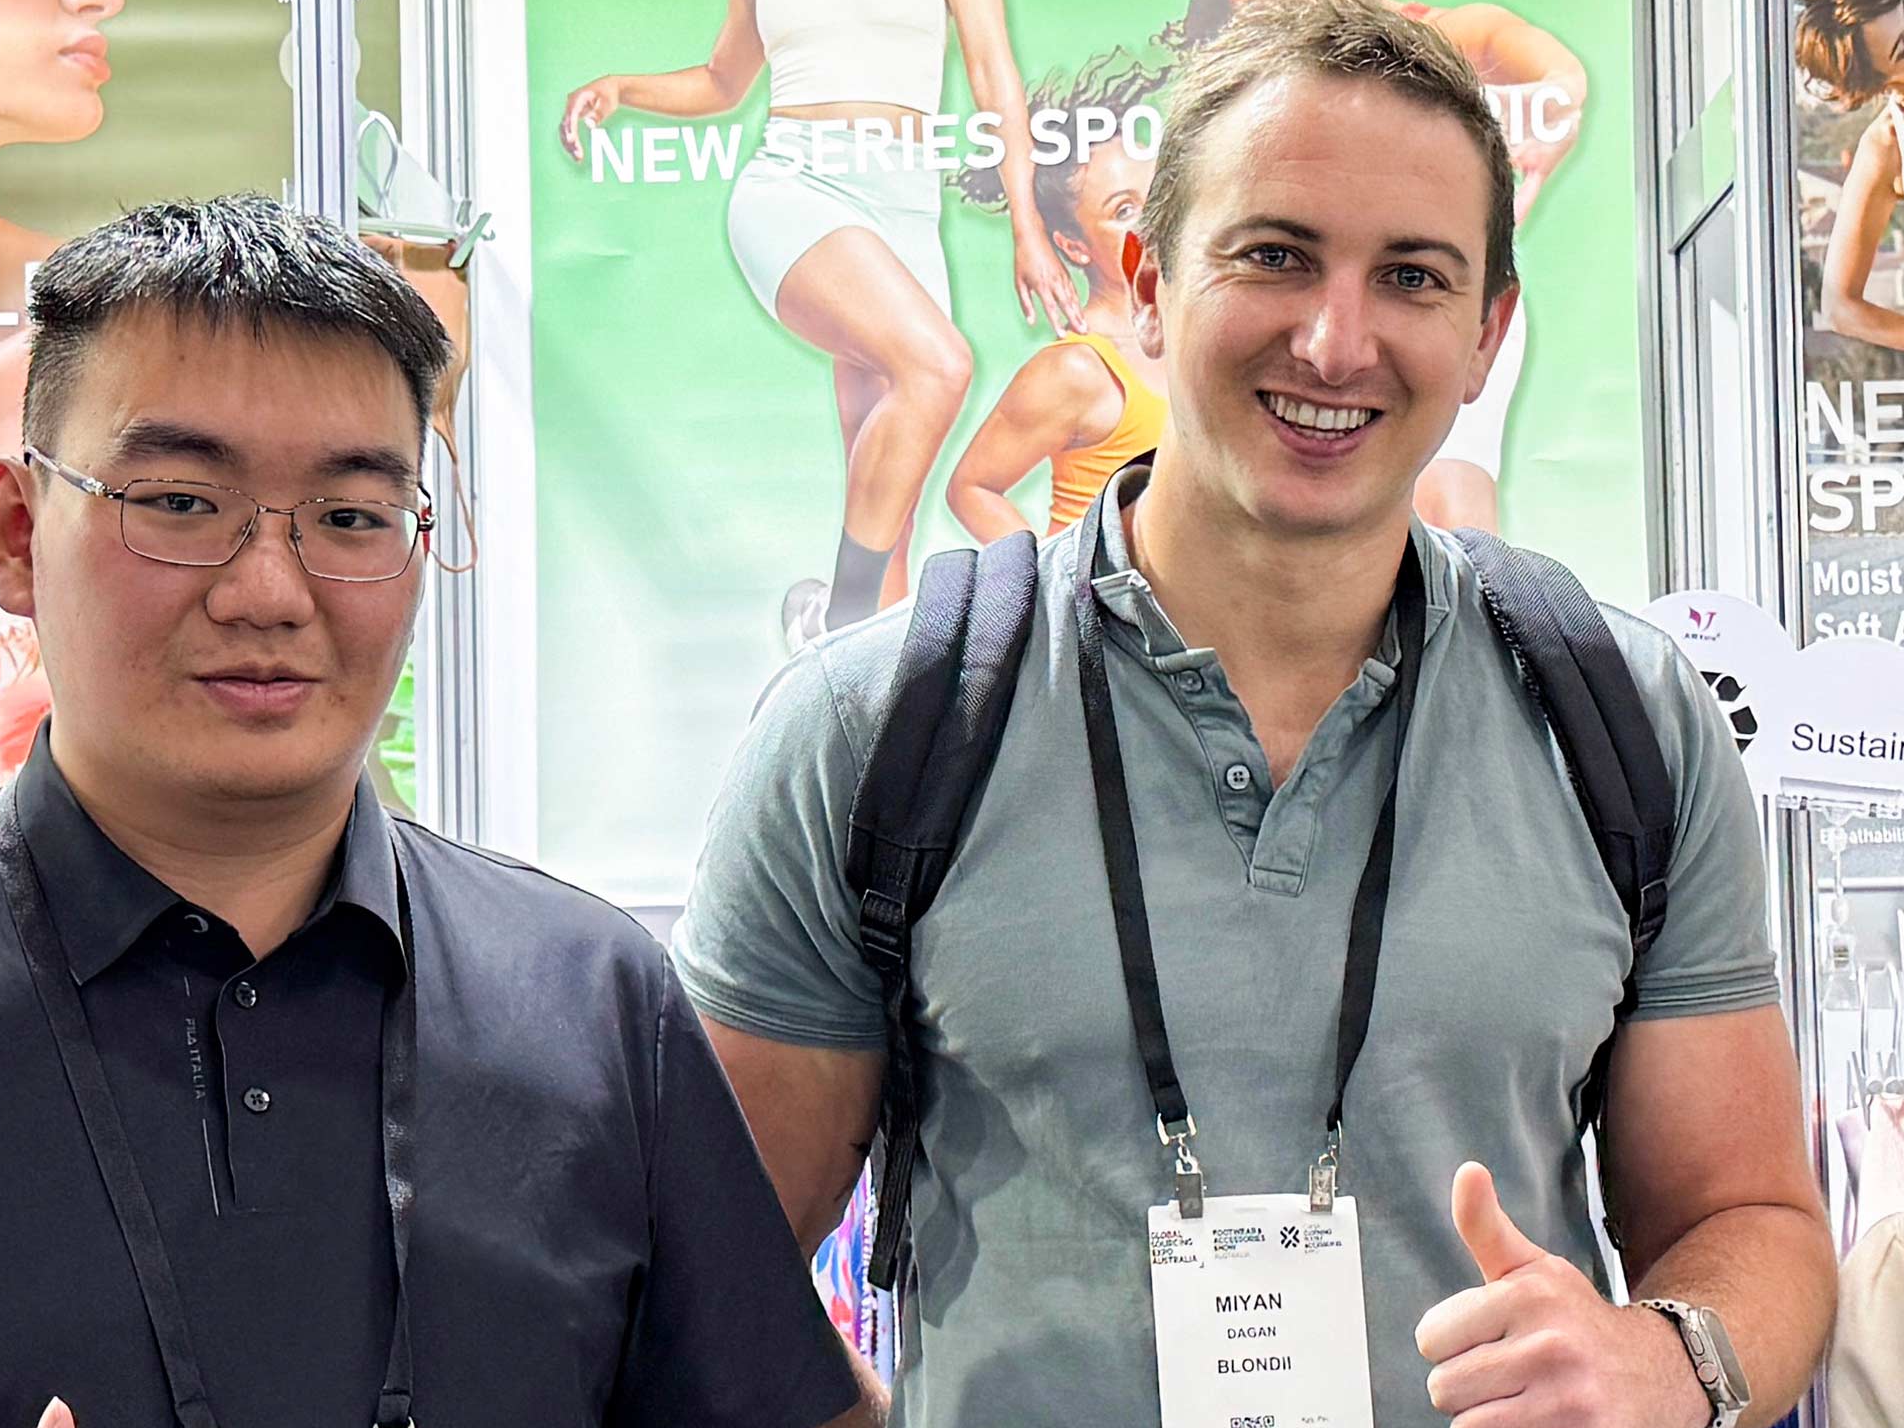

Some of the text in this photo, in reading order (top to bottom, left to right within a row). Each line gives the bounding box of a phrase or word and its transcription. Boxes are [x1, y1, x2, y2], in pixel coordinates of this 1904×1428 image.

[590, 123, 744, 184] NEW
[766, 112, 1006, 174] SERIES
[1215, 1293, 1283, 1313] MIYAN
[1227, 1326, 1277, 1340] DAGAN
[1217, 1356, 1292, 1374] BLONDII
